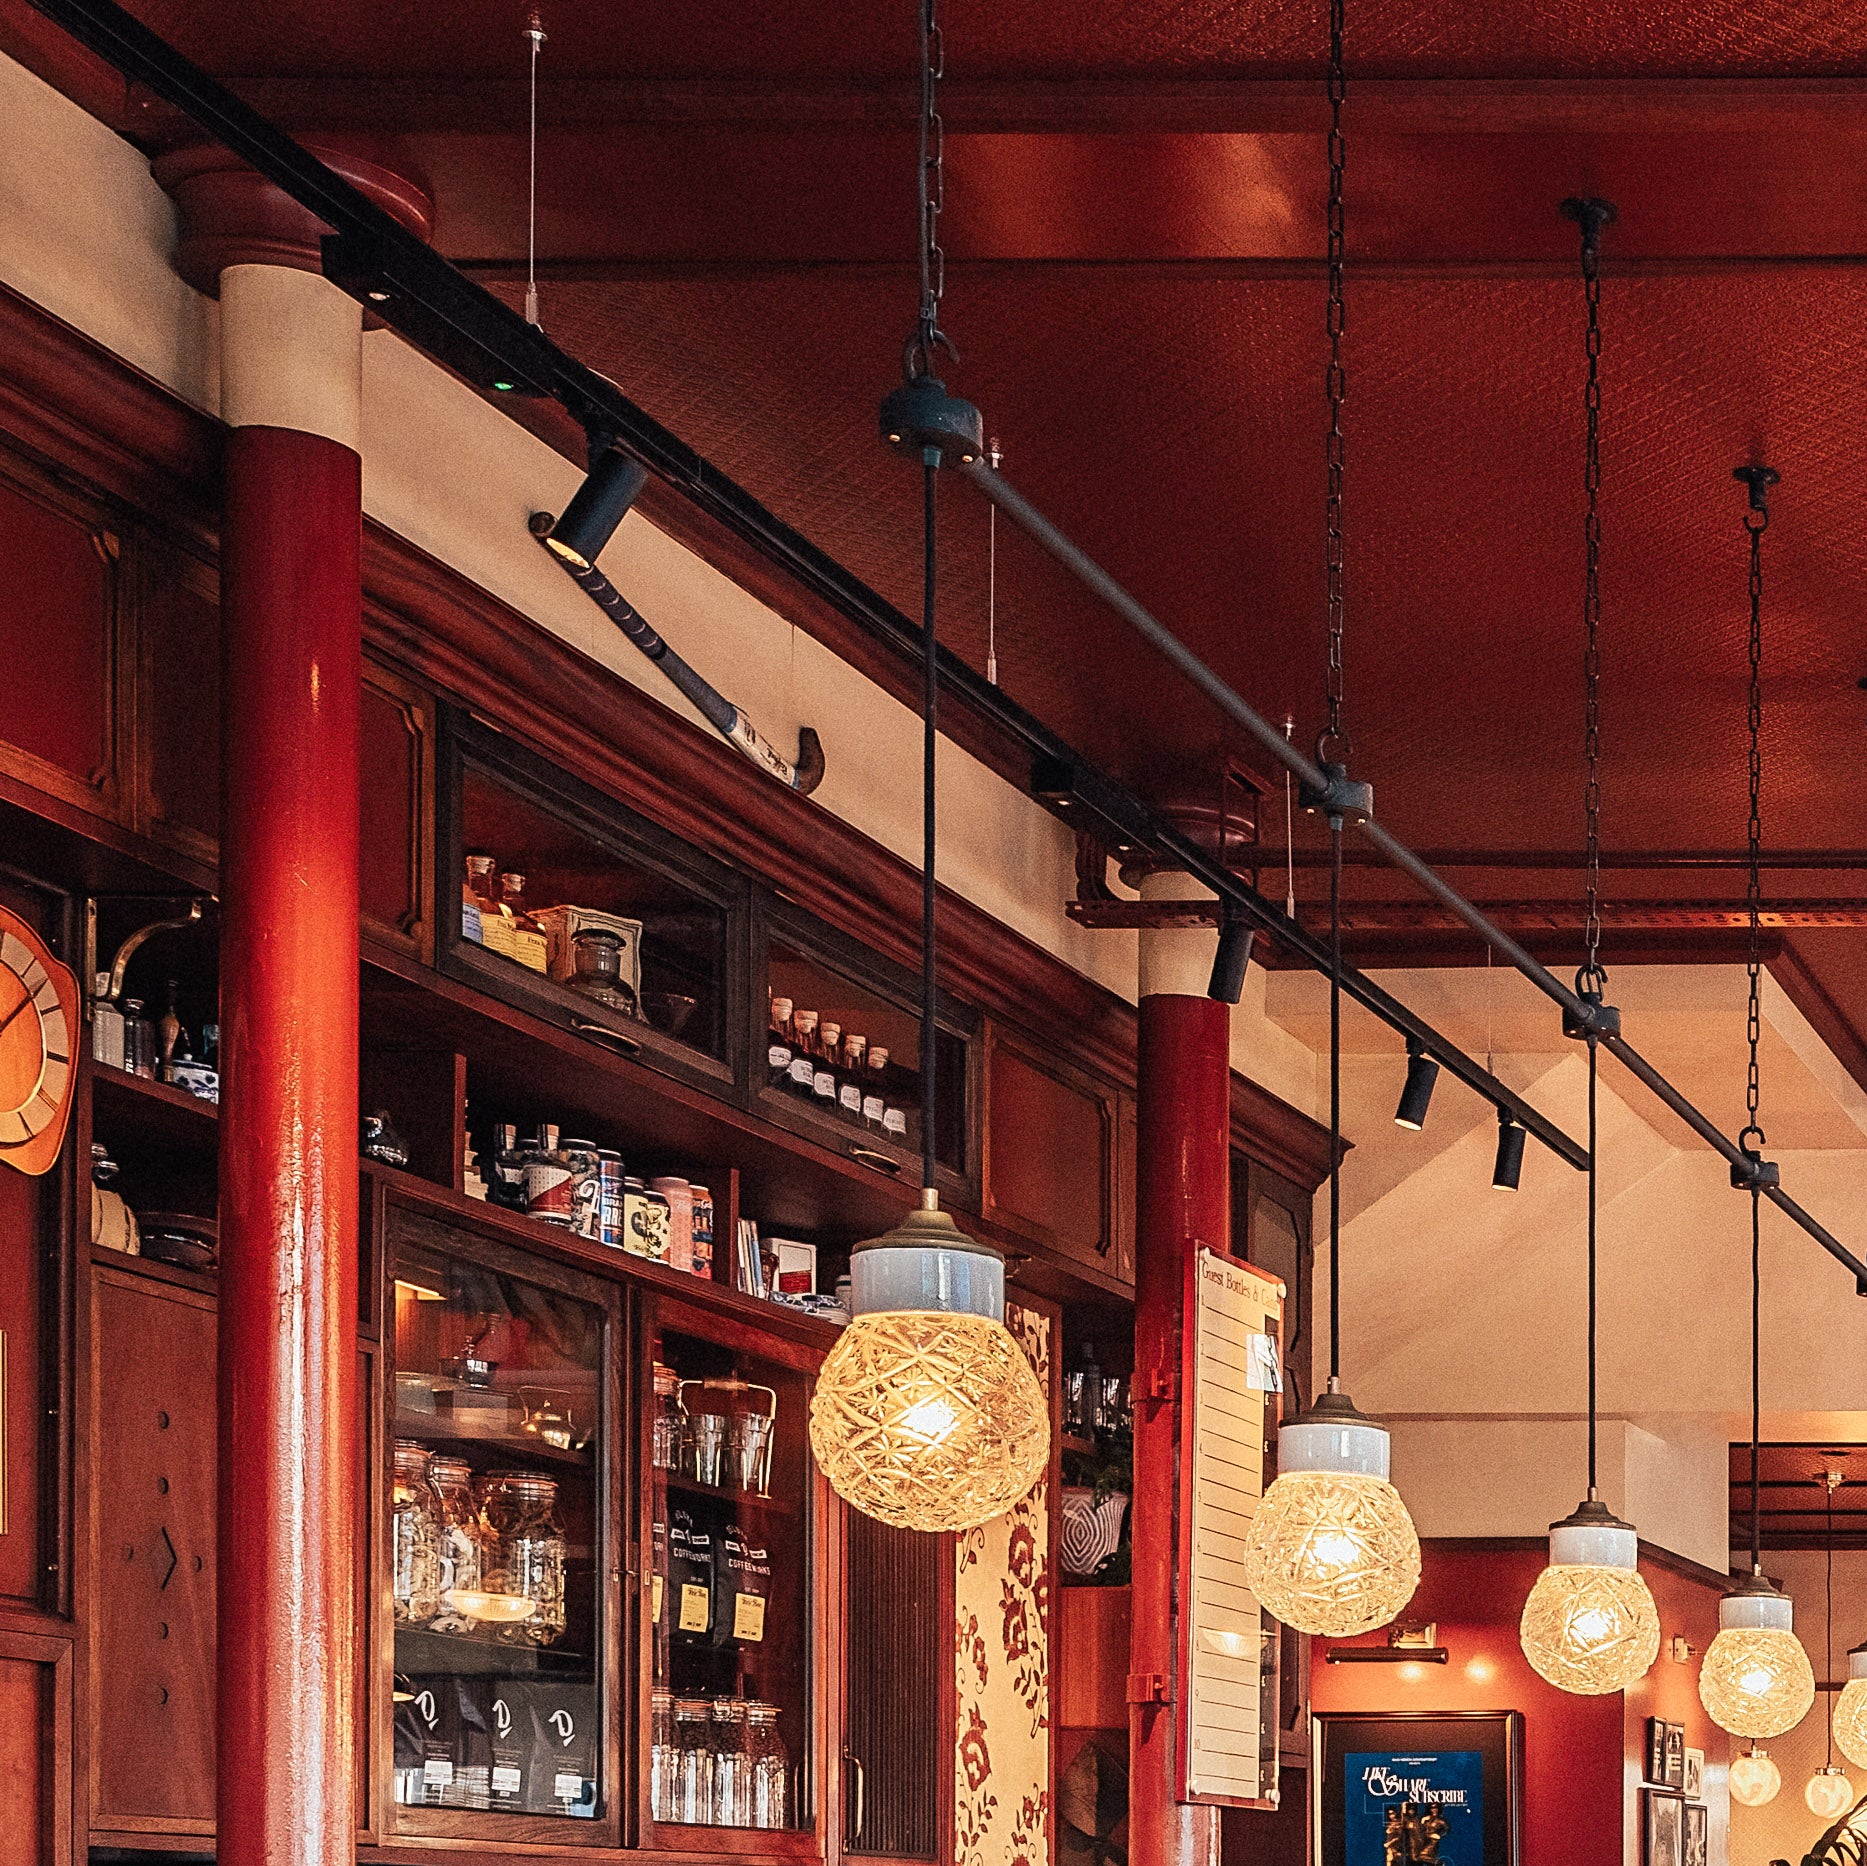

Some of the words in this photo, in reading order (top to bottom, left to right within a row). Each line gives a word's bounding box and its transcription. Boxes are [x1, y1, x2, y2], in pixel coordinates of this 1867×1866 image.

[1202, 1261, 1224, 1286] Guest
[1226, 1271, 1251, 1299] Bottles
[1409, 1789, 1468, 1803] SUBSCRIBE
